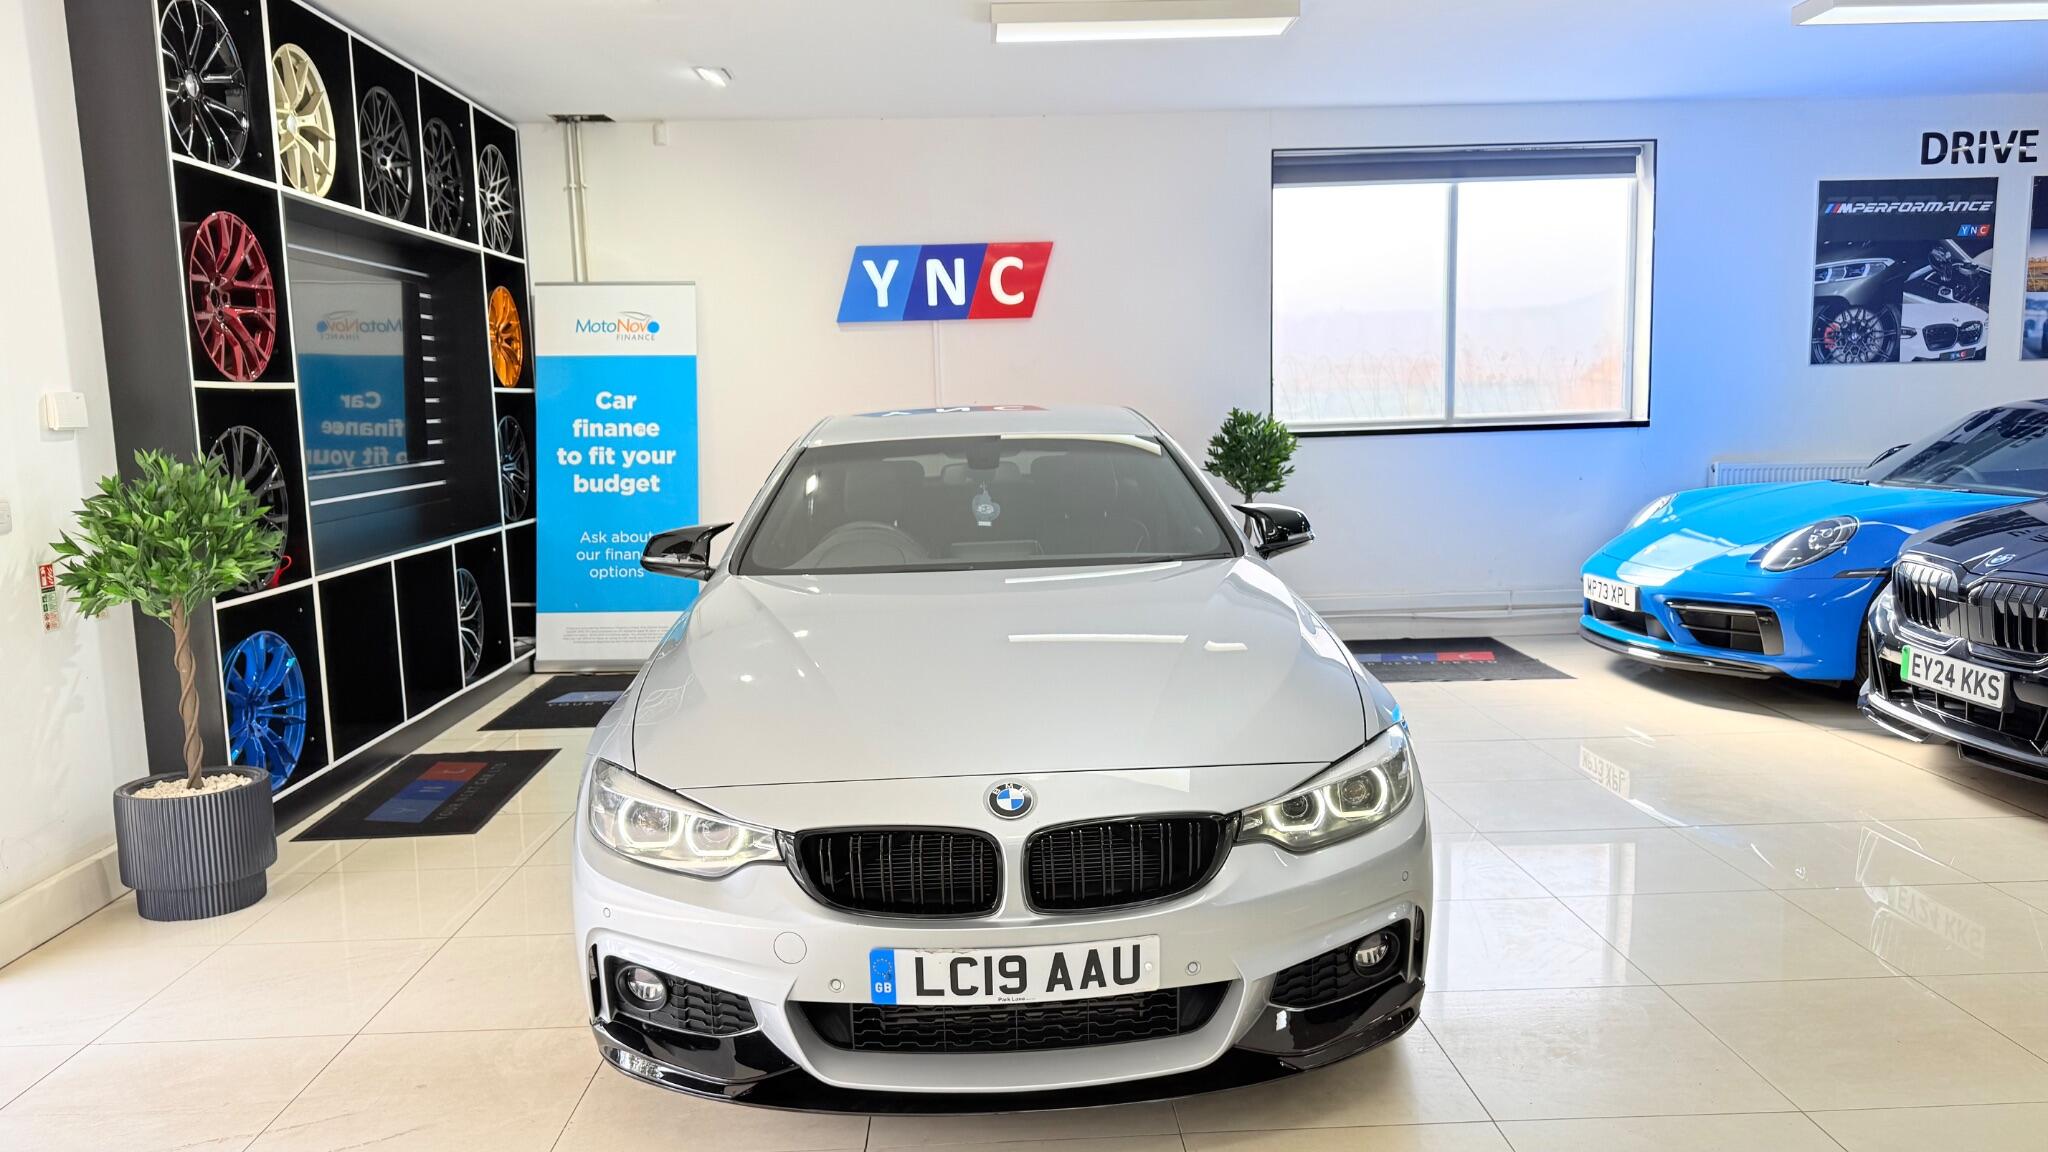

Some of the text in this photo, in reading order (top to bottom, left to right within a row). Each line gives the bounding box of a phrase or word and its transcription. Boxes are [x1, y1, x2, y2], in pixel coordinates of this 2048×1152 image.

[1920, 130, 2039, 165] DRIVE
[862, 256, 1025, 307] YNC
[616, 333, 656, 341] FINANCE
[595, 391, 637, 410] Car
[572, 419, 661, 438] finance
[556, 446, 677, 468] to fit your
[573, 474, 661, 496] budget
[580, 531, 607, 543] Ask
[576, 548, 642, 561] our finan
[589, 566, 644, 580] options
[1611, 585, 1630, 606] XPL
[1912, 653, 2000, 701] EY24 KKS
[914, 944, 1141, 997] LC19 AAU
[875, 982, 892, 993] GB
